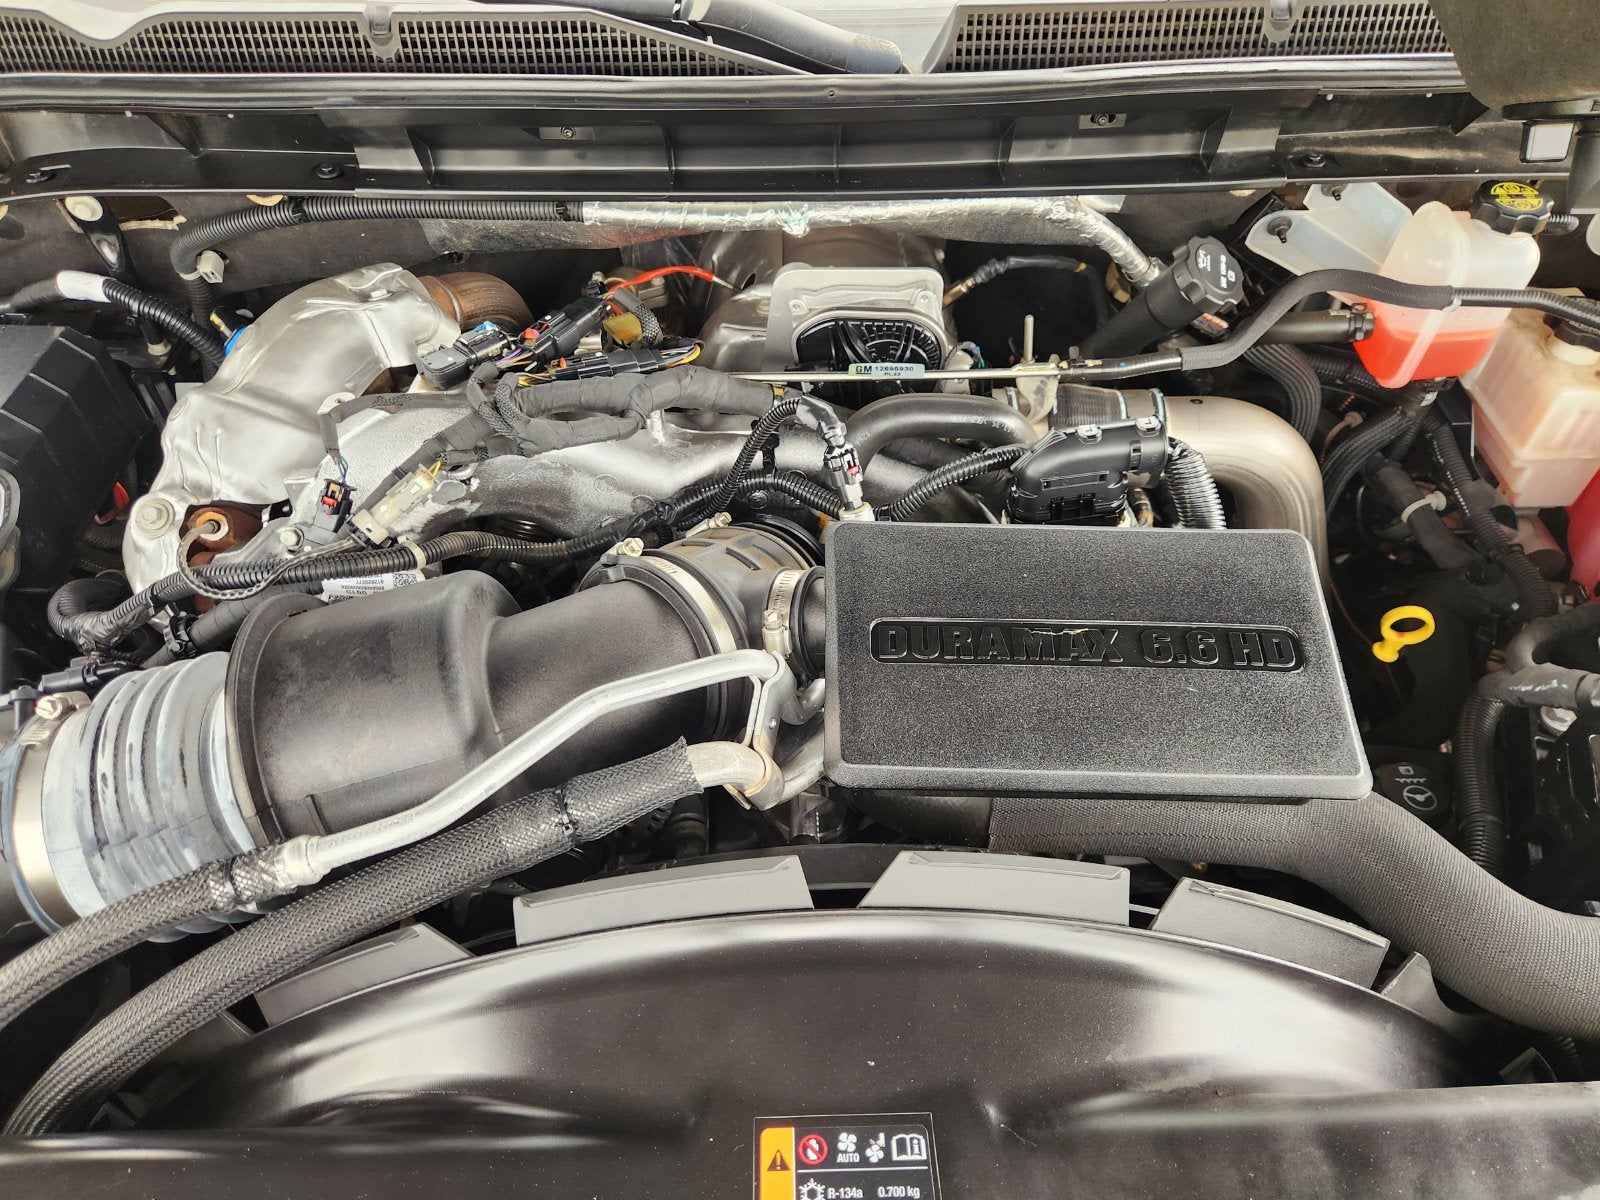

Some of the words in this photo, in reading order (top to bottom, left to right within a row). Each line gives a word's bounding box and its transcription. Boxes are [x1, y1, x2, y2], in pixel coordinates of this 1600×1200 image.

[855, 365, 873, 373] GM
[878, 624, 1123, 663] DURAMAX
[1141, 628, 1219, 665] 6.6
[1228, 631, 1297, 668] HD
[836, 1153, 860, 1163] AUTO
[827, 1187, 864, 1199] R-134a
[877, 1186, 906, 1198] 0.700
[907, 1185, 921, 1200] kg
